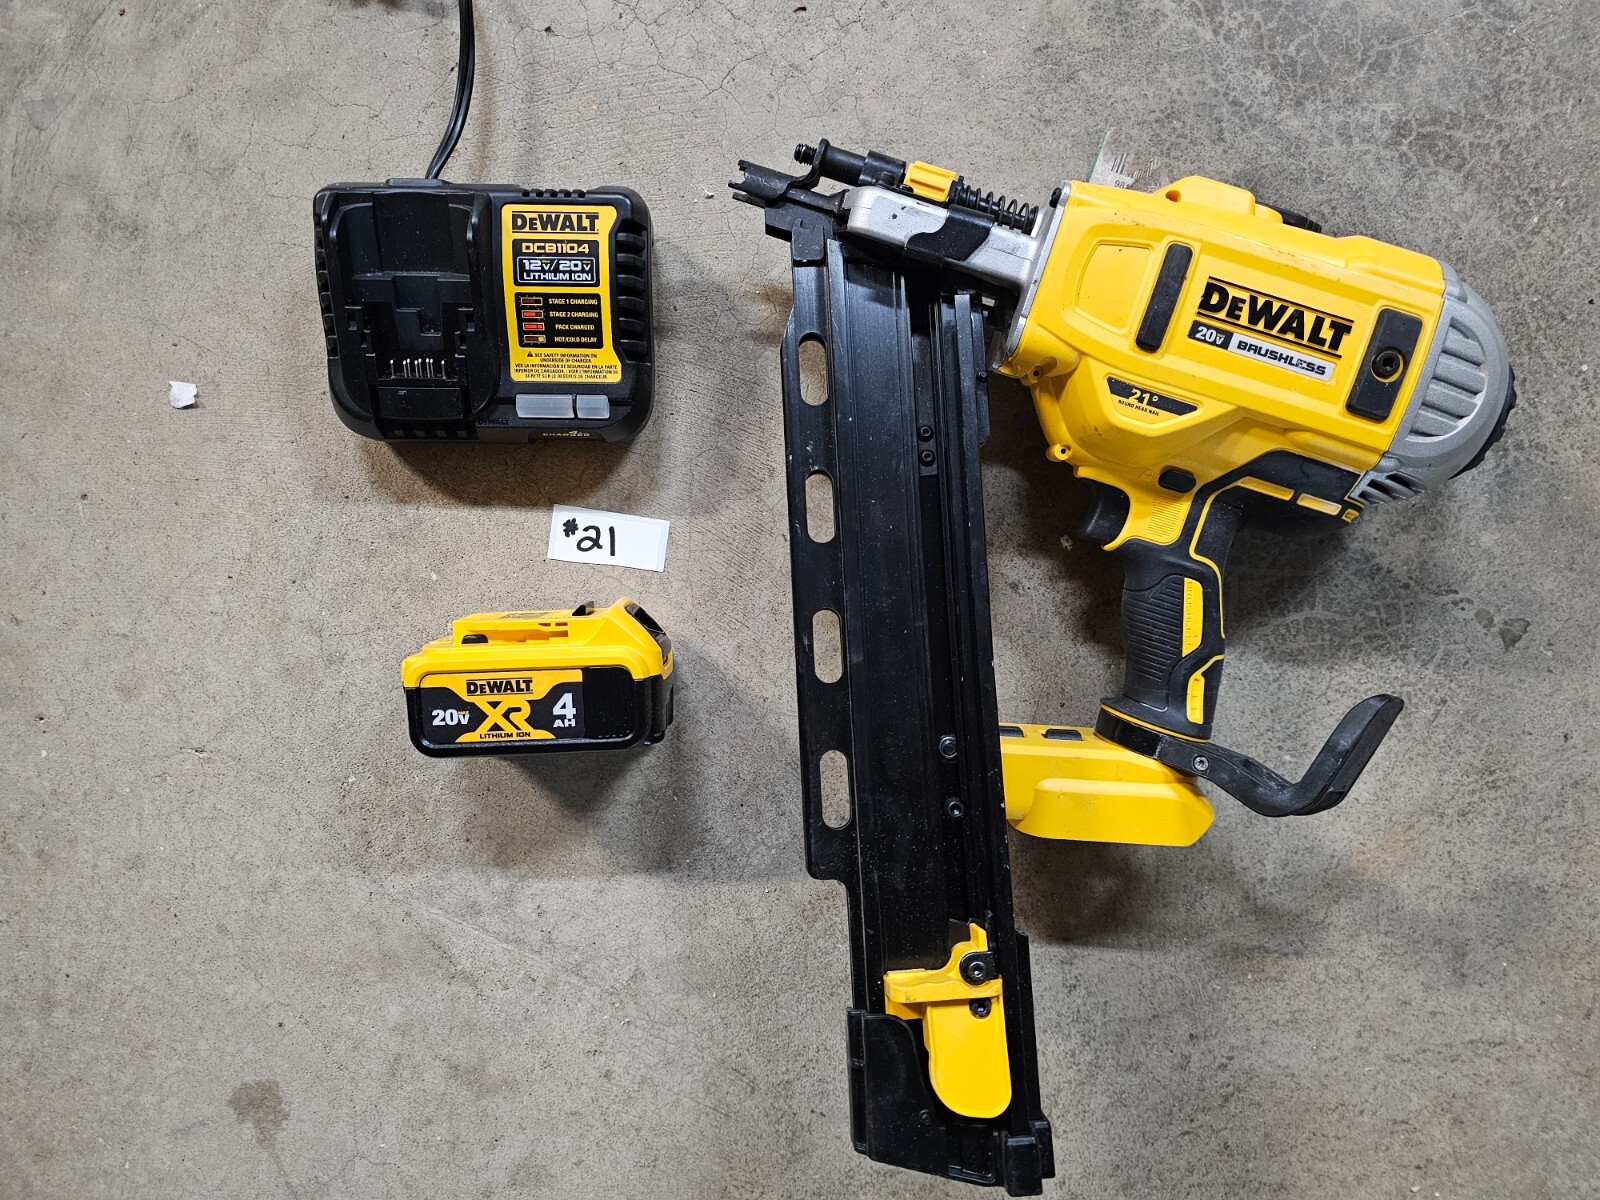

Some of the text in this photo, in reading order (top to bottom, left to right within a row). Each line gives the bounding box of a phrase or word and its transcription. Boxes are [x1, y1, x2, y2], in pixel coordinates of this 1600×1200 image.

[512, 213, 599, 232] DEWALT
[522, 242, 589, 253] DCB1104
[523, 272, 591, 281] LITHIUM ION
[1198, 279, 1354, 352] DEWALT
[1236, 340, 1327, 376] BRUSHLESS
[1117, 399, 1135, 408] ROUND
[1135, 405, 1148, 413] HEAD
[562, 517, 616, 557] #21
[466, 680, 533, 694] DEWALT
[473, 699, 535, 732] XR
[553, 693, 577, 719] 4
[552, 719, 576, 728] AH
